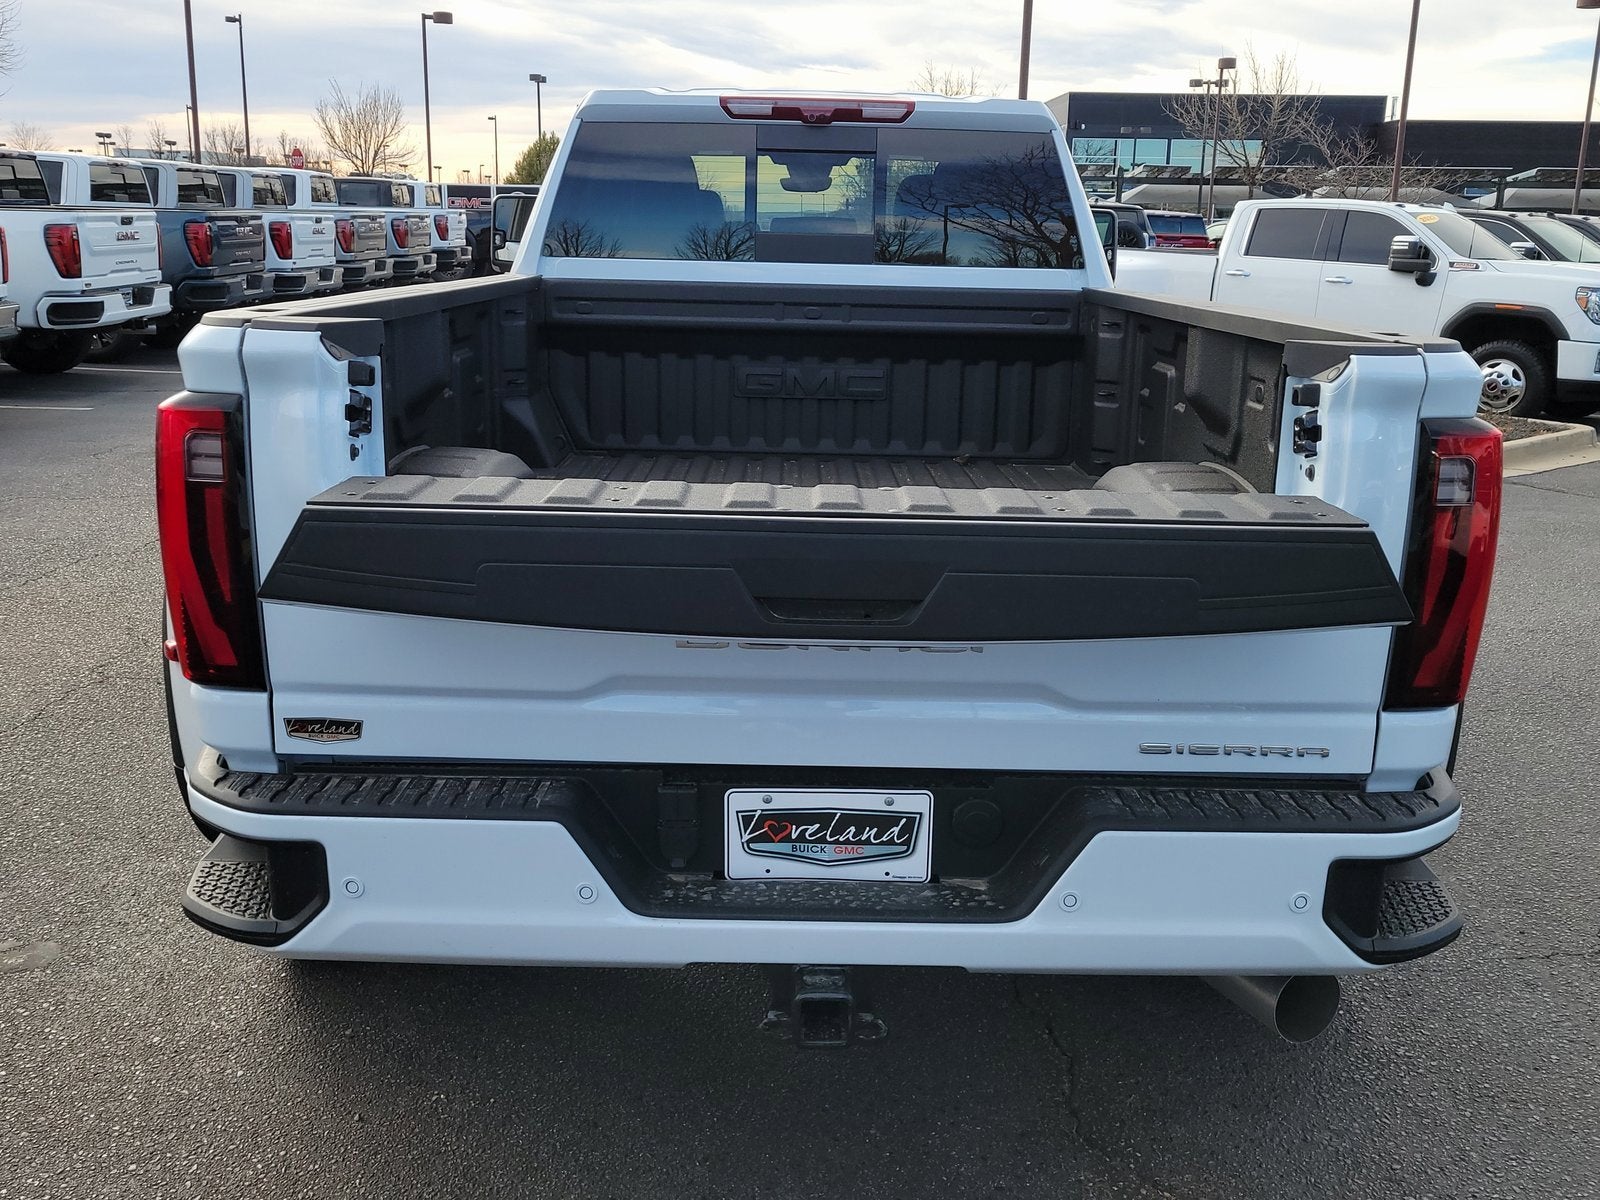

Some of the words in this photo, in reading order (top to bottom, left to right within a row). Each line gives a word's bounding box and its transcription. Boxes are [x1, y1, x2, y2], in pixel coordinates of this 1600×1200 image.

[292, 155, 303, 166] STOP
[448, 196, 491, 208] GMC
[116, 231, 140, 241] GMC
[737, 366, 887, 398] GMC
[1139, 742, 1331, 758] SIERRA
[791, 844, 827, 854] BUICK
[833, 846, 865, 856] GMC
